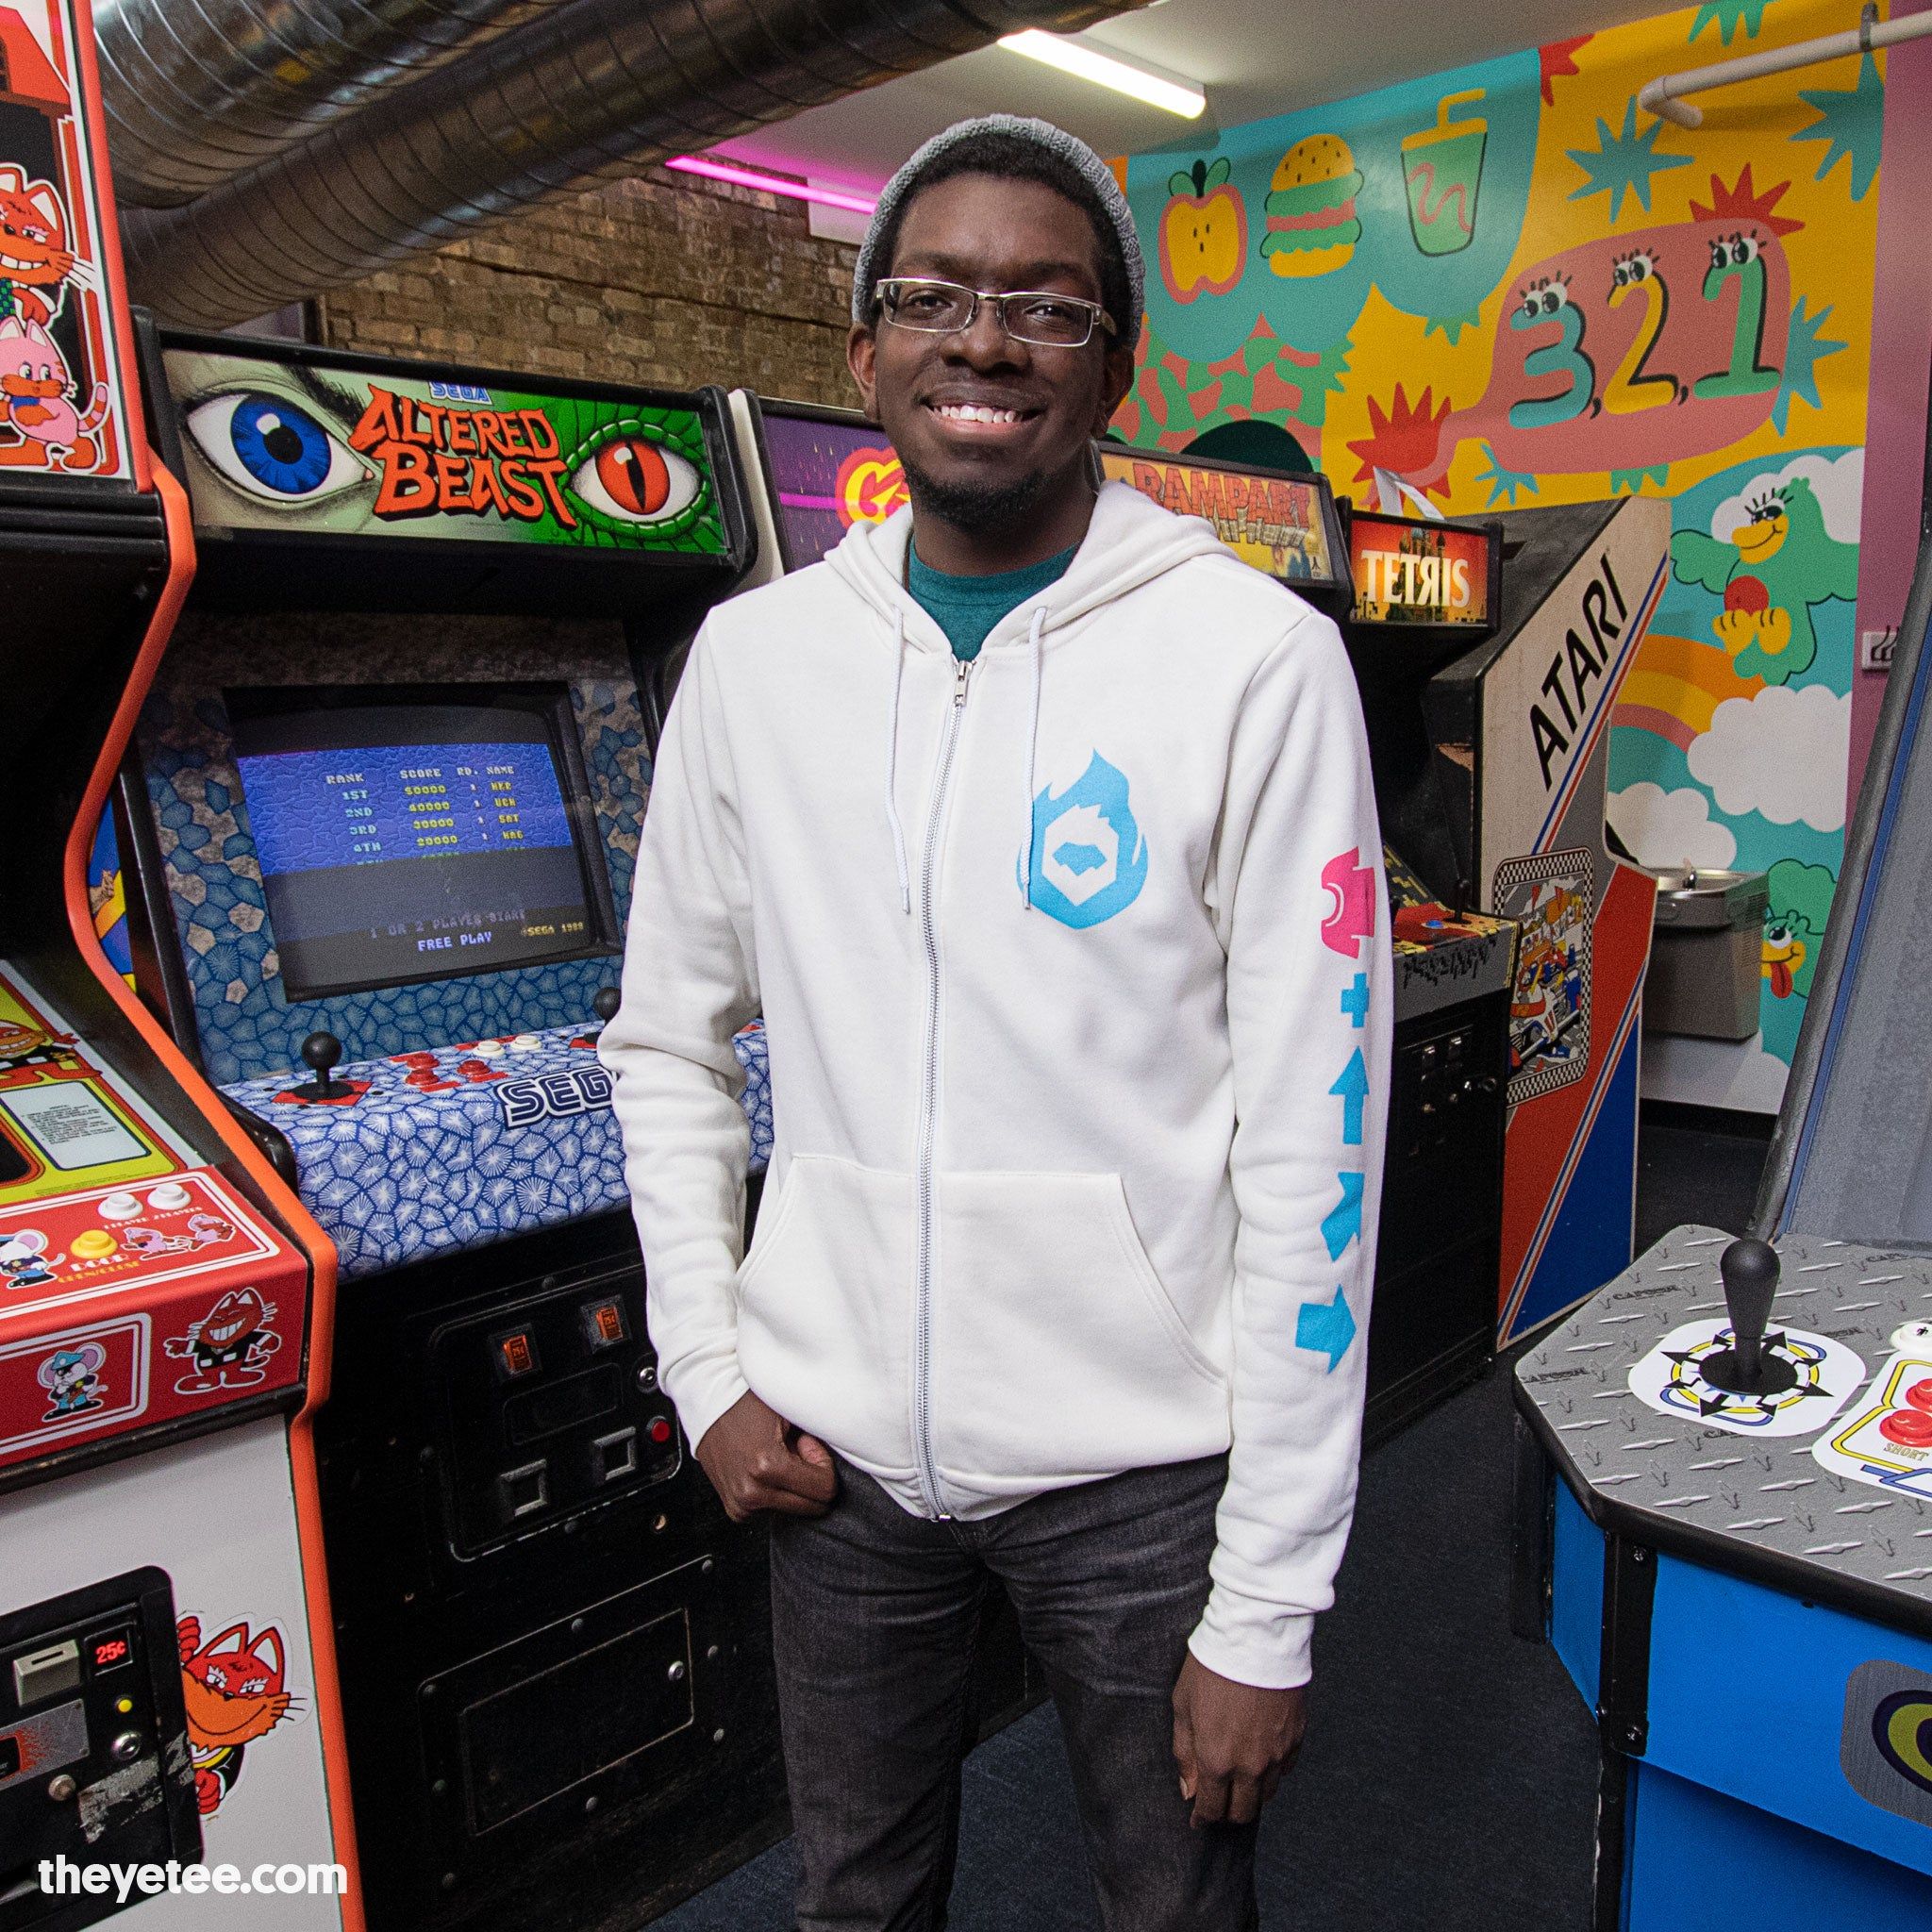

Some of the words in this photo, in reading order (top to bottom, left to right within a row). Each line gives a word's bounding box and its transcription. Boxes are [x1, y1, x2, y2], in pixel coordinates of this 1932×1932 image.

[431, 381, 491, 402] SEGA
[348, 383, 559, 458] ALTERED
[370, 440, 577, 529] BEAST
[1132, 462, 1310, 530] RAMPART
[1530, 553, 1627, 791] ATARI
[326, 774, 364, 784] RANK
[400, 768, 441, 779] SCORE
[486, 765, 514, 774] NAME
[342, 790, 368, 800] 1ST
[345, 808, 373, 818] 2ND
[349, 824, 376, 835] 3RD
[354, 841, 382, 853] 4TH
[417, 937, 453, 952] FREE
[459, 931, 491, 945] PLAY
[494, 1064, 619, 1130] SEG
[1884, 1442, 1929, 1461] SHORT
[96, 1641, 125, 1664] 25¢
